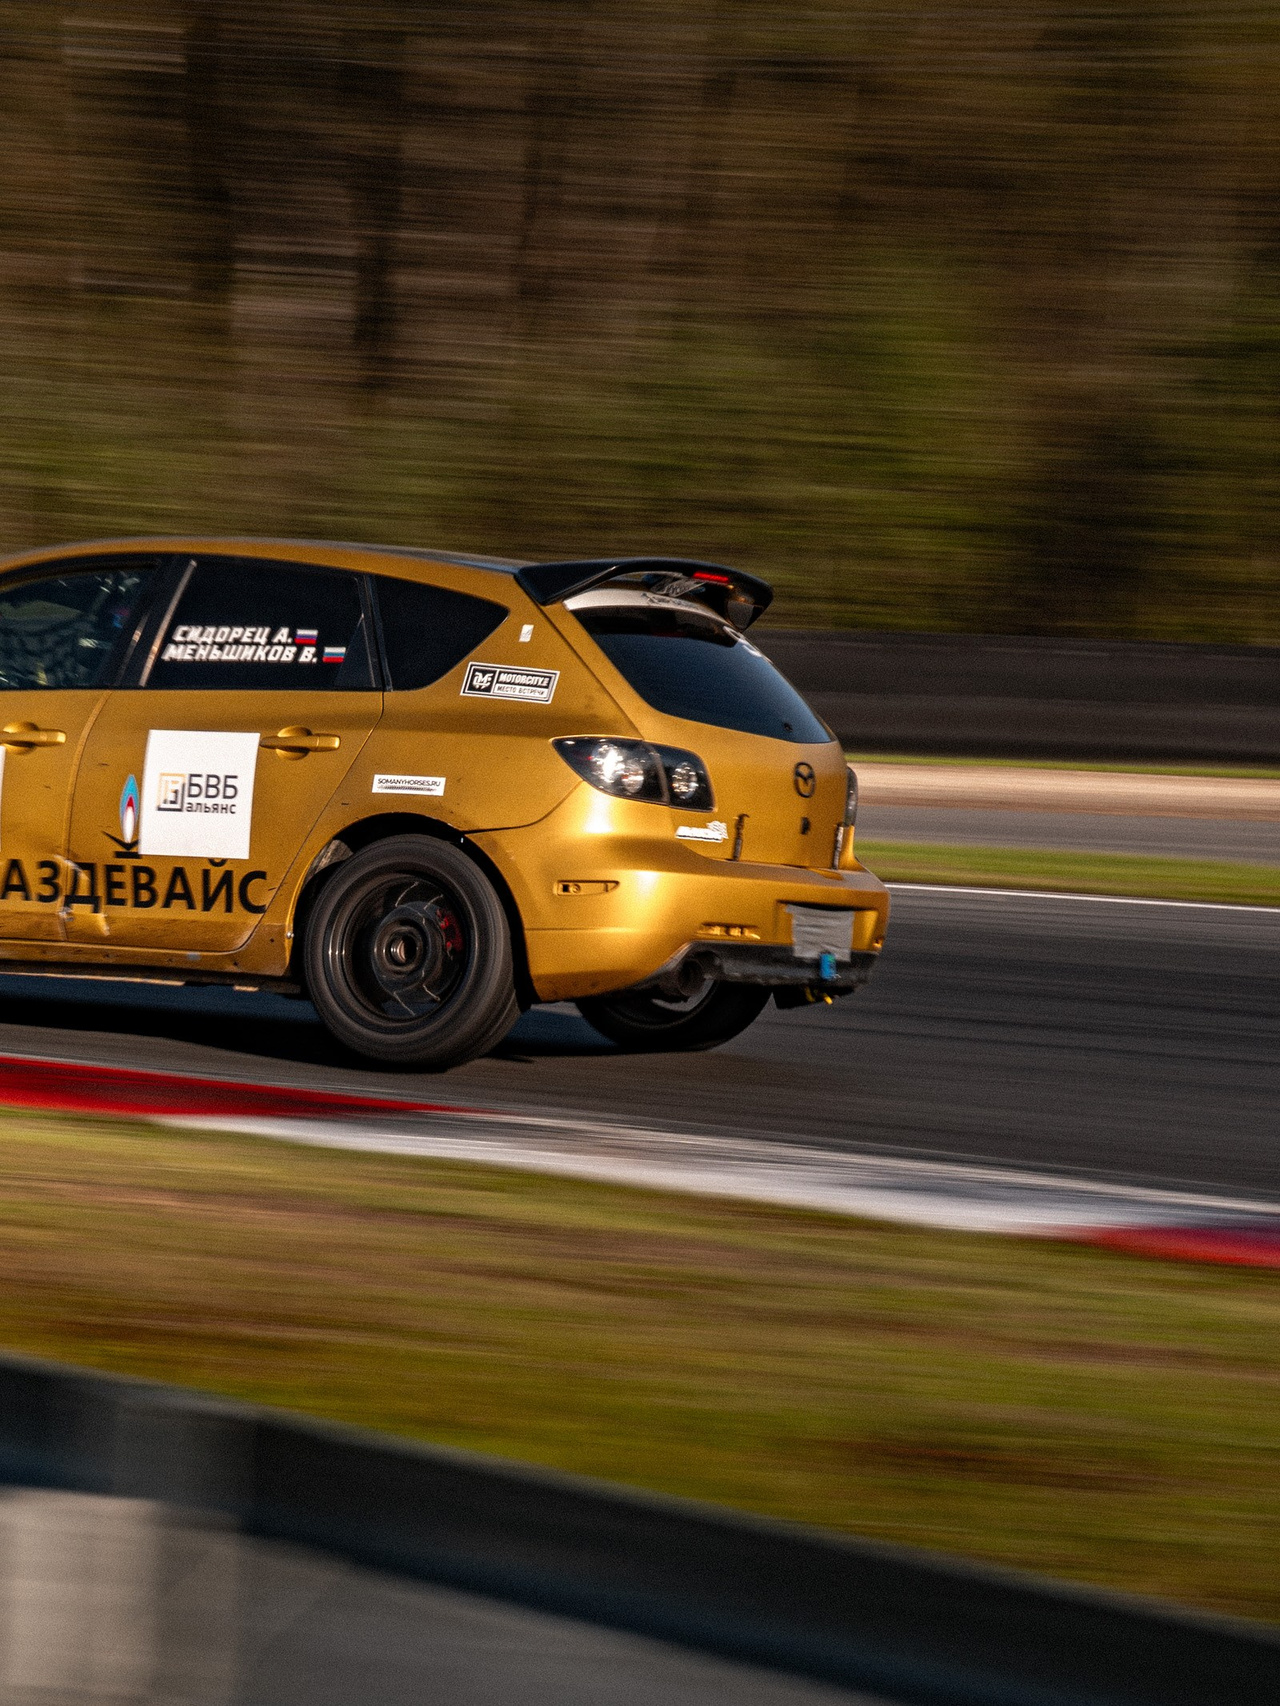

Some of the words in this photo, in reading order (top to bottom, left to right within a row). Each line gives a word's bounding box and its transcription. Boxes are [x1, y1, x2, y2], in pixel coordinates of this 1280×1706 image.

[172, 625, 271, 644] СИДОРЕЦ
[271, 627, 292, 643] А.
[161, 643, 297, 662] МЕНЬШИКОВ
[298, 646, 318, 663] В.
[187, 773, 238, 800] БВБ
[185, 802, 237, 814] альянс
